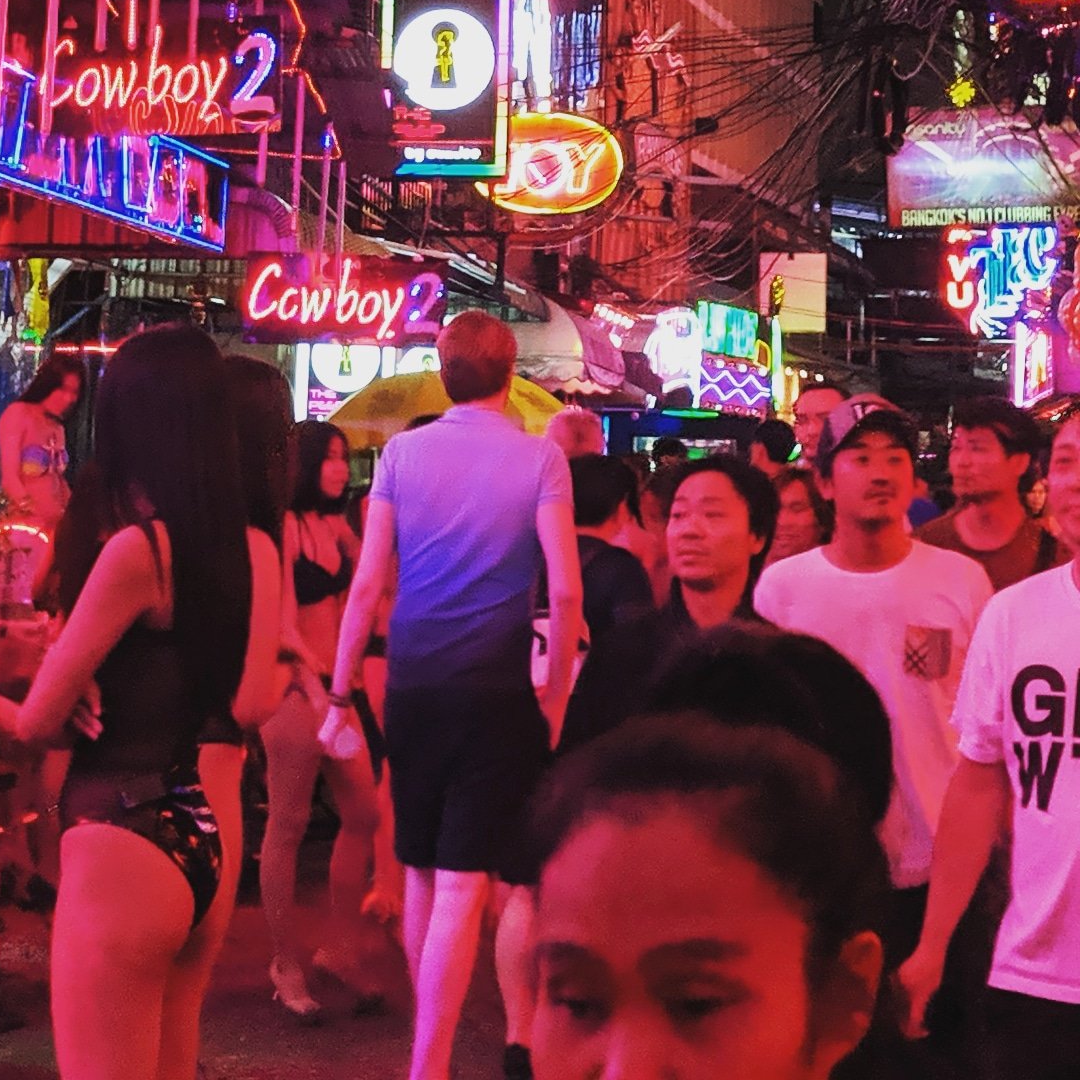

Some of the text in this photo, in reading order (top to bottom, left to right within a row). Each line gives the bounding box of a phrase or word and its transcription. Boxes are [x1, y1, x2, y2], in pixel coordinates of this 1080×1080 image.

[229, 31, 276, 115] 2
[493, 140, 606, 196] JOY
[901, 207, 967, 227] BANGKOK'S
[994, 205, 1052, 224] CLUBBING
[248, 257, 447, 340] Cowboy 2
[1011, 664, 1080, 739] G
[1012, 741, 1080, 813] W
